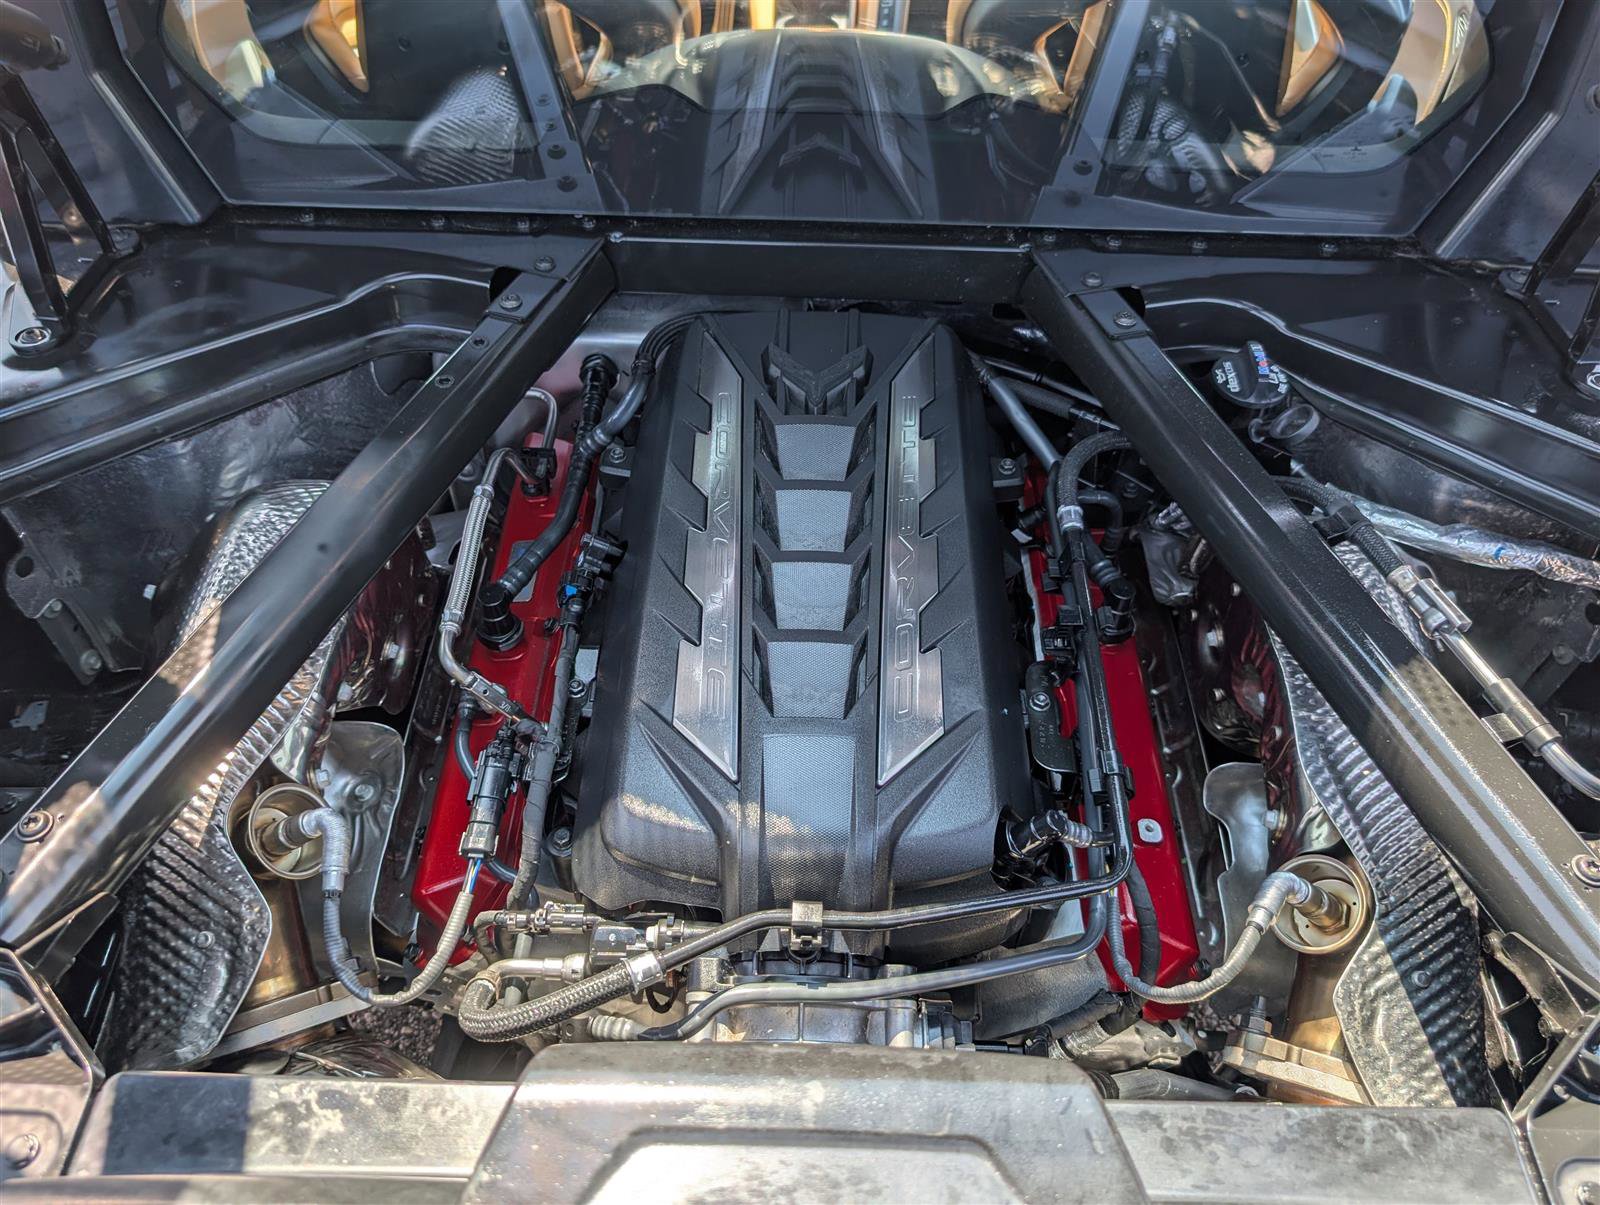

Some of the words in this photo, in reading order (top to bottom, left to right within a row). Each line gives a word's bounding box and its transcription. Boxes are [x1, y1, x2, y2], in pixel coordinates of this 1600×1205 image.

[1223, 361, 1240, 392] dexos
[706, 392, 731, 720] CORVETTE
[894, 395, 917, 722] CORVETTE
